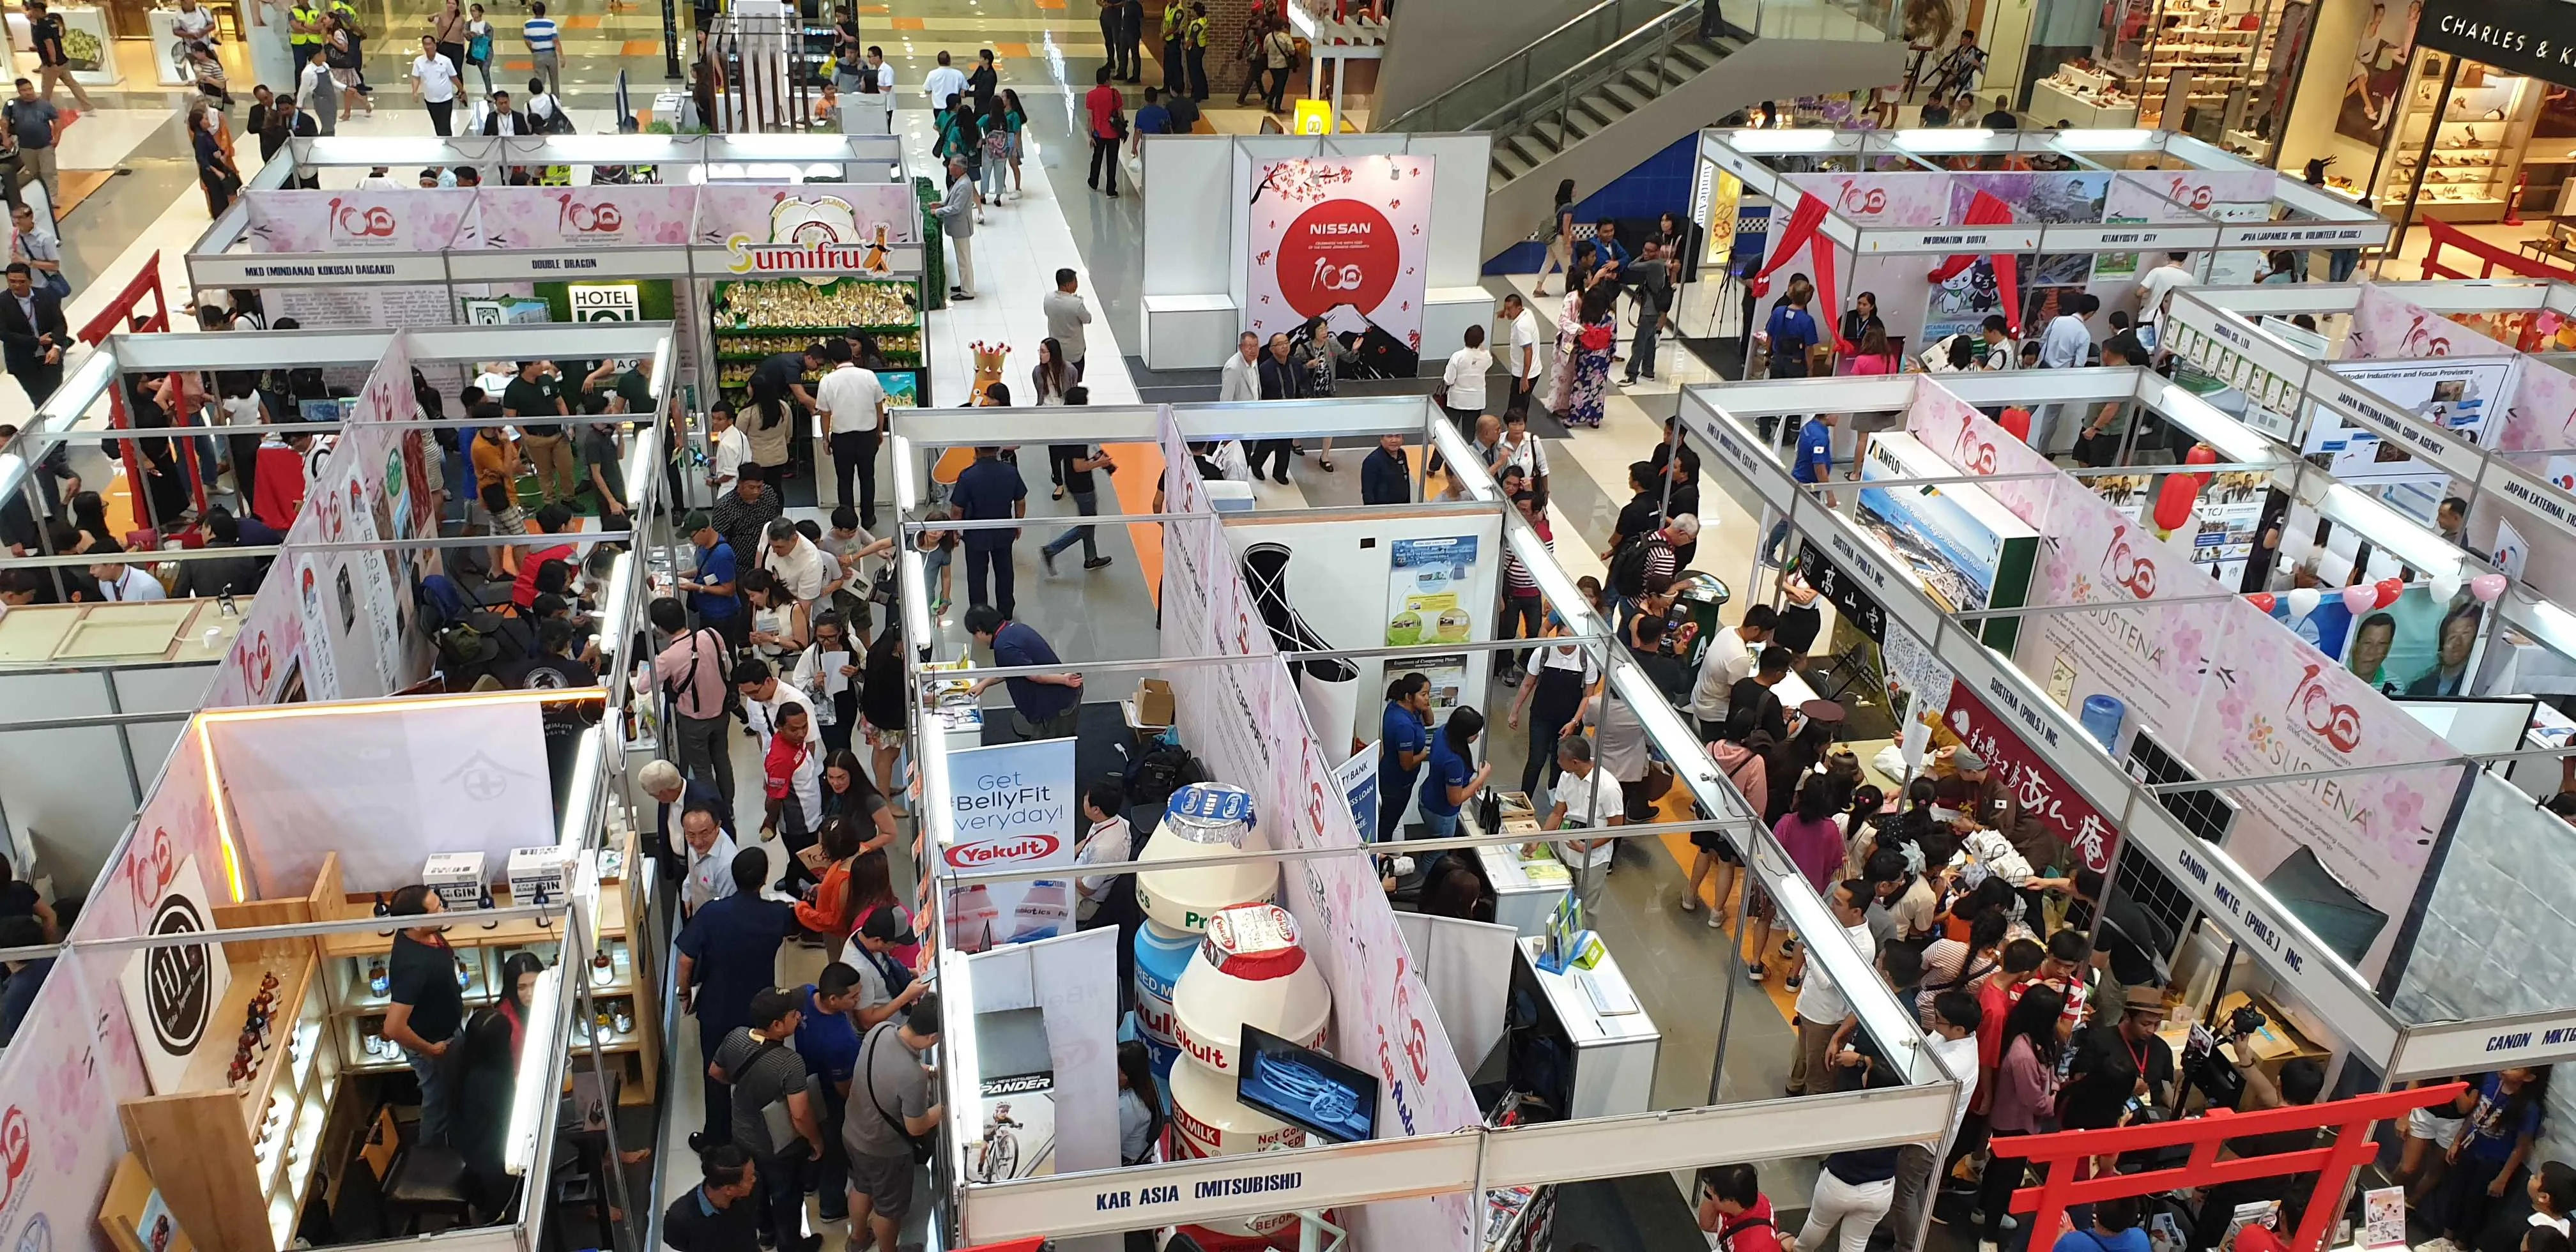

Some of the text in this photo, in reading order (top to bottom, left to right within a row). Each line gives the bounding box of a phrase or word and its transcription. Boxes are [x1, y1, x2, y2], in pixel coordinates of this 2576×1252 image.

[2441, 15, 2526, 52] CHARLES
[2536, 40, 2550, 58] &
[1310, 222, 1371, 235] NISSAN
[2143, 234, 2158, 242] CITY
[1923, 235, 1986, 245] INFORMATION BOOTH
[532, 258, 597, 270] DOUBLE DRAGON
[727, 234, 860, 274] Sumifru
[245, 267, 265, 277] MKD
[576, 291, 633, 305] HOTEL
[2366, 370, 2402, 379] Industries
[2337, 392, 2444, 455] JAPAN INTERNATIONAL COOP. AGENCY
[1742, 453, 1758, 475] ESTATE
[1878, 448, 1900, 475] ANFLO
[2504, 480, 2529, 500] JAPAN
[2529, 491, 2565, 521] EXTERNAL
[2207, 507, 2223, 517] TCJ
[1968, 555, 1981, 572] Hub
[1990, 676, 2058, 749] SUSTENA (PHILS.) INC.
[977, 770, 1022, 791] Get
[1350, 760, 1368, 781] BANK
[1359, 783, 1374, 802] LOAN
[954, 804, 1064, 832] veryday!
[963, 840, 1044, 862] Yakult
[454, 887, 477, 897] GIN
[2178, 849, 2303, 975] CANON MKTG. (PHILS.) INC.
[1216, 920, 1234, 948] Yakult
[1275, 912, 1291, 939] Yakult
[2485, 1032, 2533, 1052] CANON
[979, 1078, 1051, 1094] PANDER
[1186, 1118, 1216, 1143] MILK
[1258, 1132, 1280, 1145] Net
[1096, 1172, 1302, 1211] KAR ASIA (MITSUBISHI)
